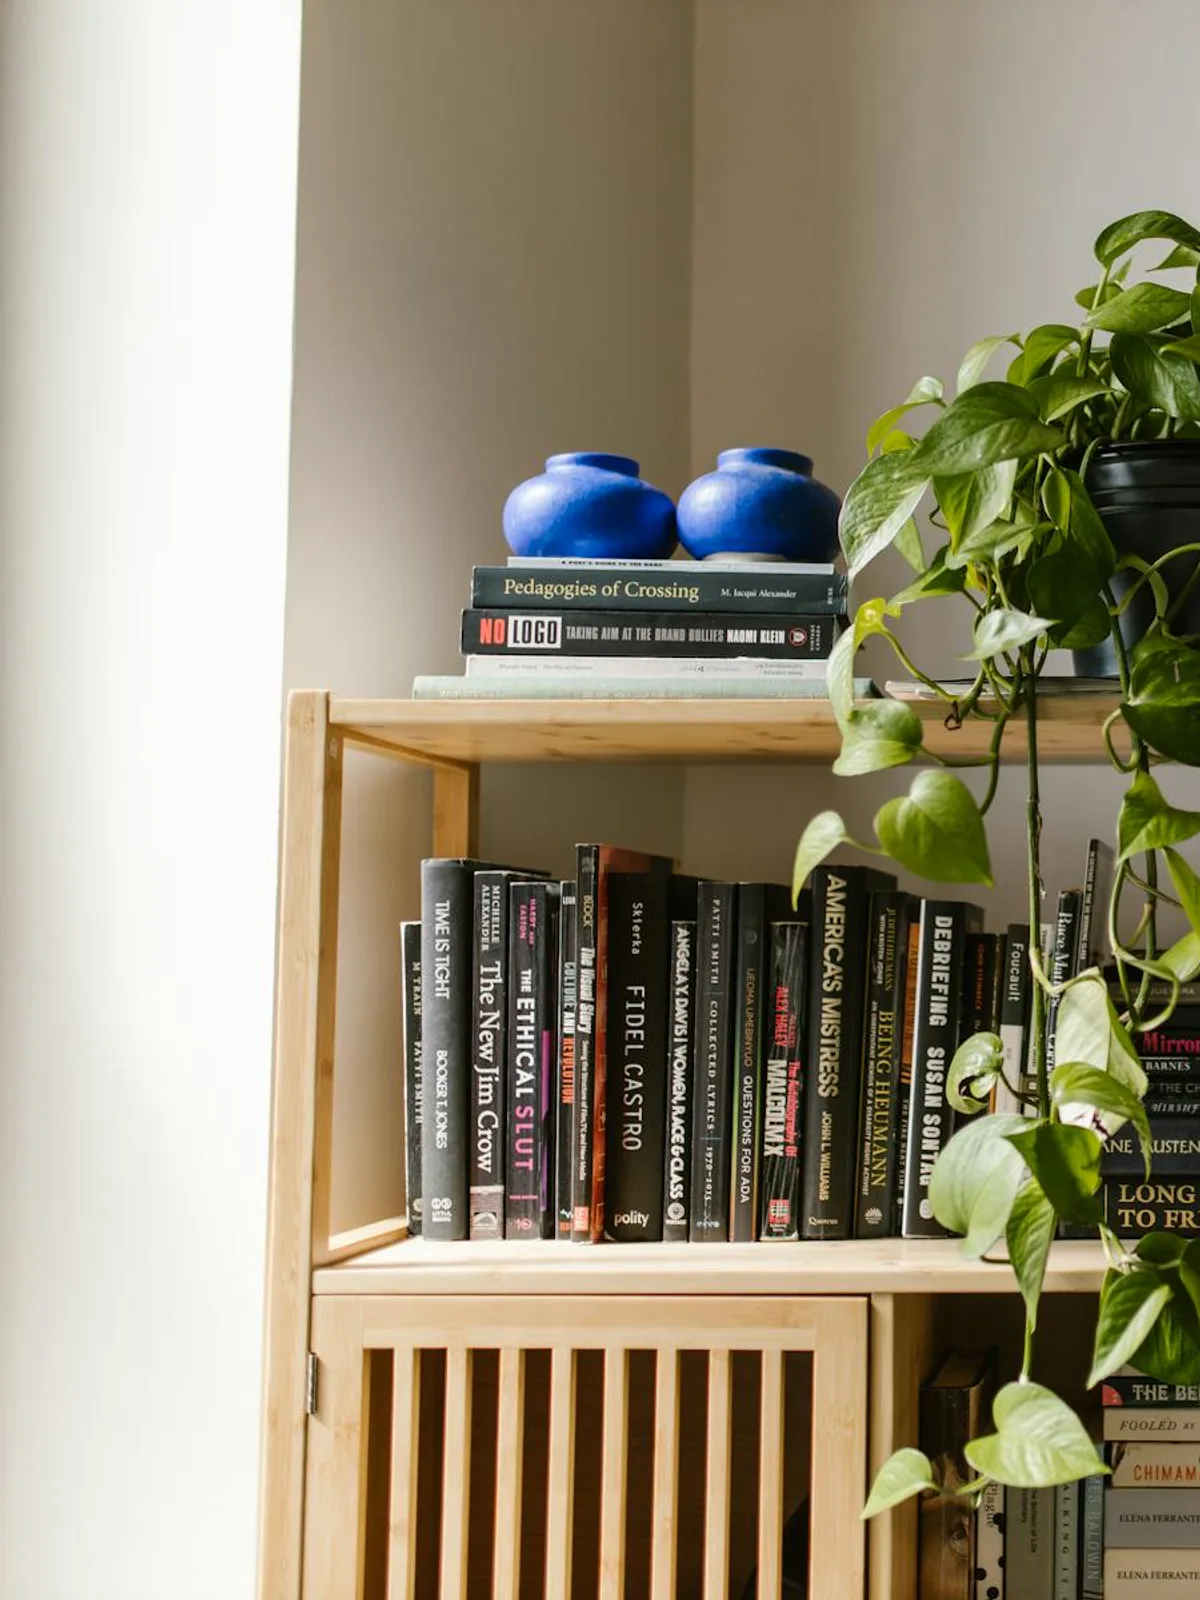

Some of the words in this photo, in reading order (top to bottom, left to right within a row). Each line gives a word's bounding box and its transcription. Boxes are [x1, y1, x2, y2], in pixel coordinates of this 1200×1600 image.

[504, 578, 597, 601] Pedagogies
[602, 580, 623, 597] of
[625, 581, 700, 603] Crossing
[721, 588, 732, 598] M.
[734, 588, 757, 600] Jacqui
[759, 589, 798, 599] Alexander
[480, 618, 506, 645] NO
[512, 619, 558, 645] LOGO
[566, 626, 599, 640] TAKING
[601, 627, 620, 641] AIM
[622, 628, 635, 641] AT
[636, 628, 652, 642] THE
[655, 628, 686, 642] BRAND
[688, 629, 724, 643] BULLIES
[727, 629, 757, 644] NAOMI
[760, 630, 786, 644] KLEIN
[434, 900, 450, 935] TIME
[481, 884, 491, 952] ALEXANDER
[491, 884, 501, 944] MICHELLE
[583, 895, 594, 928] BLOCK
[631, 901, 644, 956] Skierka
[711, 899, 721, 936] PATTI
[1056, 911, 1074, 949] Race
[434, 938, 450, 953] IS
[821, 873, 847, 993] AMERICA'S
[580, 947, 596, 967] The
[675, 927, 691, 985] ANGELA
[710, 942, 720, 984] SMITH
[929, 915, 953, 1027] DEBRIEFING
[1007, 942, 1026, 1002] Foucault
[434, 954, 450, 1000] TIGHT
[479, 961, 503, 1005] The
[520, 968, 532, 993] THE
[563, 961, 577, 1010] CULTURE
[579, 969, 595, 1002] Visual
[576, 1003, 594, 1035] Story
[674, 998, 689, 1036] DAVIS
[776, 986, 790, 1012] ALEX
[478, 1009, 500, 1062] New
[562, 1011, 576, 1034] AND
[624, 985, 646, 1056] FIDEL
[707, 1000, 718, 1079] COLLECTED
[774, 1013, 788, 1047] HALEY
[516, 997, 536, 1099] ETHICAL
[817, 997, 842, 1098] MISTRESS
[876, 1010, 897, 1074] BEING
[436, 1050, 448, 1099] BOOKER
[473, 1064, 501, 1105] Jim
[561, 1037, 575, 1104] REVOLUTION
[671, 1044, 687, 1105] WOMEN,
[924, 1046, 946, 1108] SUSAN
[1146, 1061, 1191, 1071] BARNES
[436, 1099, 448, 1109] T.
[622, 1063, 644, 1151] CASTRO
[706, 1084, 716, 1130] LYRICS
[741, 1075, 753, 1145] QUESTIONS
[764, 1059, 787, 1143] MALCOLM
[435, 1110, 448, 1150] JONES
[477, 1109, 499, 1173] Crow
[514, 1104, 534, 1172] SLUT
[671, 1105, 686, 1144] RACE
[822, 1110, 832, 1142] JOHN
[870, 1081, 891, 1187] HEUMANN
[740, 1148, 752, 1173] FOR
[763, 1143, 784, 1157] X
[669, 1157, 684, 1199] CLASS
[739, 1176, 751, 1203] ADA
[819, 1151, 831, 1201] WILLIAMS
[1118, 1184, 1197, 1205] LONG
[613, 1209, 650, 1228] polity
[1117, 1209, 1156, 1229] TO
[1163, 1209, 1200, 1229] FR
[1132, 1384, 1168, 1401] THE
[1120, 1420, 1178, 1431] FOOLED
[985, 1482, 1000, 1529] Plague
[1119, 1514, 1151, 1523] ELENA
[1086, 1511, 1100, 1581] BALDWIN
[1117, 1570, 1148, 1580] ELENA
